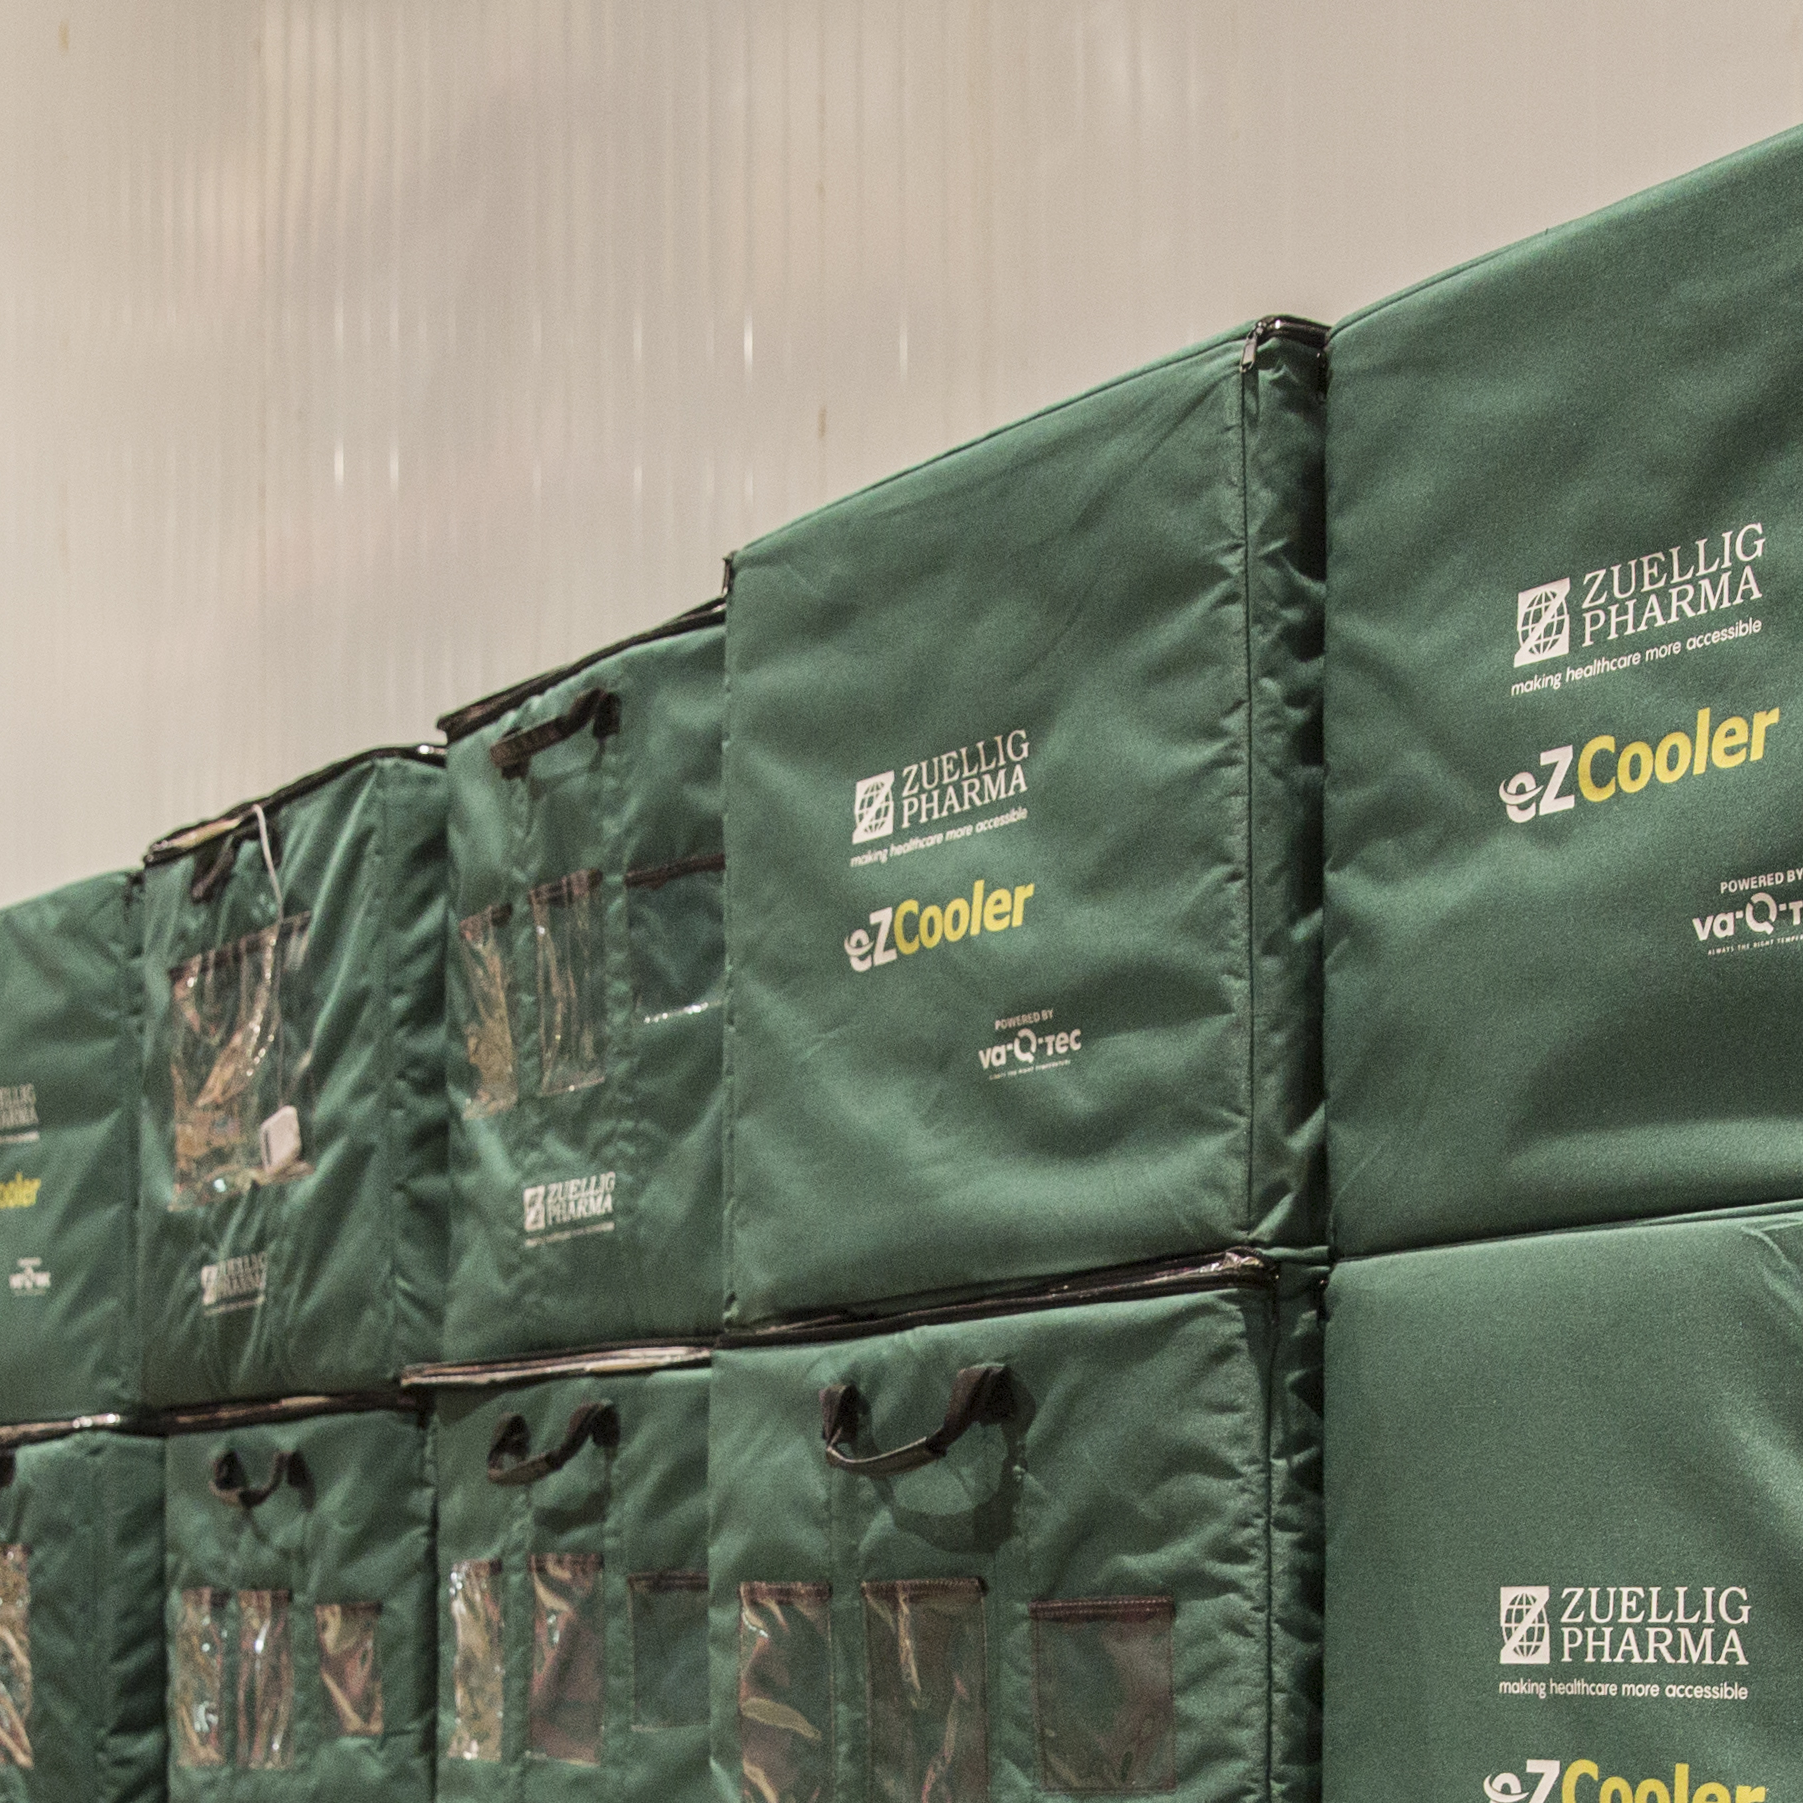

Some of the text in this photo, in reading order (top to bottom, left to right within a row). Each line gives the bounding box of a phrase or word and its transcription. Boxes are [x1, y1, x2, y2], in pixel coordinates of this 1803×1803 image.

[1581, 522, 1766, 609] ZUELLIG
[1581, 566, 1763, 647] PHARMA
[1511, 617, 1763, 697] making healthcare more accessible
[901, 729, 1031, 797] ZUELLIG
[900, 764, 1029, 829] PHARMA
[1720, 867, 1803, 894] POWERED BY
[1560, 1586, 1752, 1625] ZUELLIG
[1560, 1626, 1749, 1665] PHARMA
[1498, 1677, 1749, 1701] making healthcare more accessible
